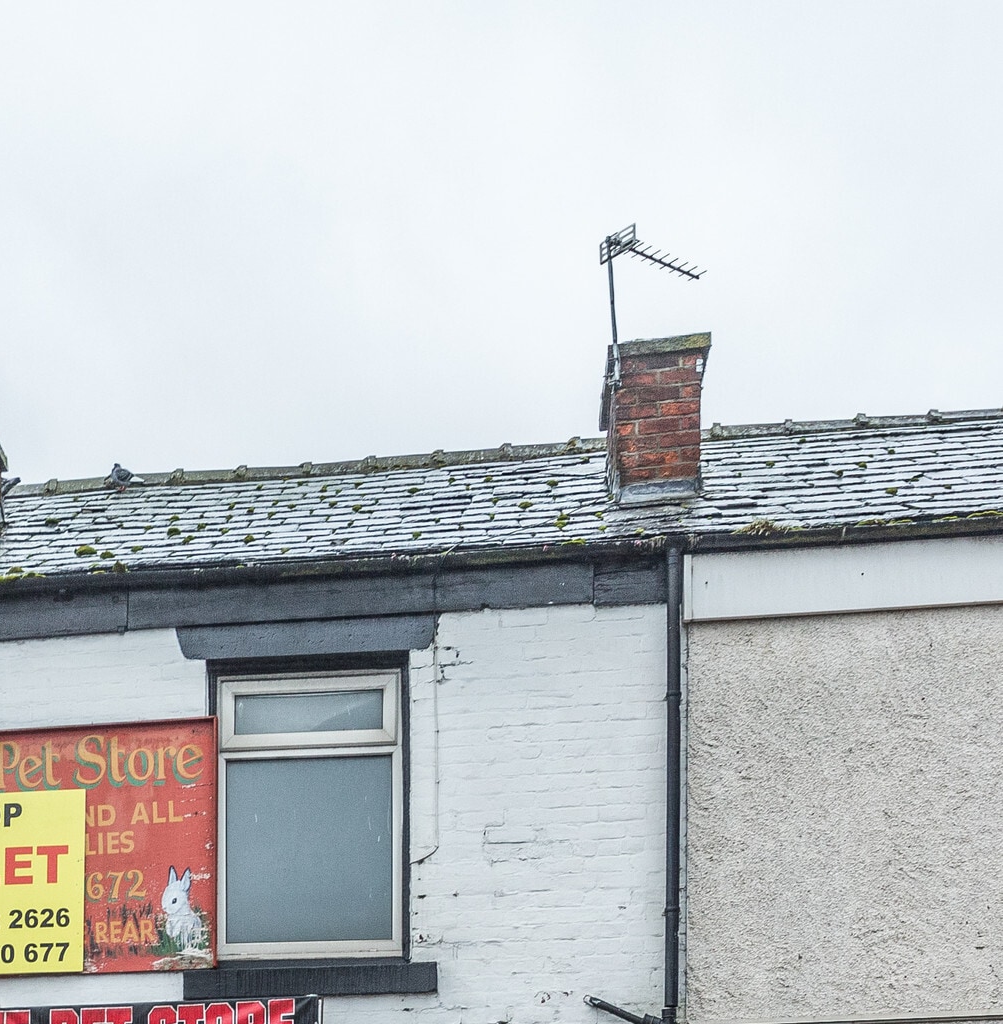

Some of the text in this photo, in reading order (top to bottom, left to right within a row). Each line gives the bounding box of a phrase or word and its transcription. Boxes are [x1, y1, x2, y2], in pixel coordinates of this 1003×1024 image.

[72, 734, 204, 790] Store
[131, 800, 184, 825] ALL
[86, 830, 135, 856] LIES
[85, 869, 147, 902] 672
[9, 907, 70, 929] 2626
[95, 919, 158, 943] REAR
[24, 942, 70, 963] 677
